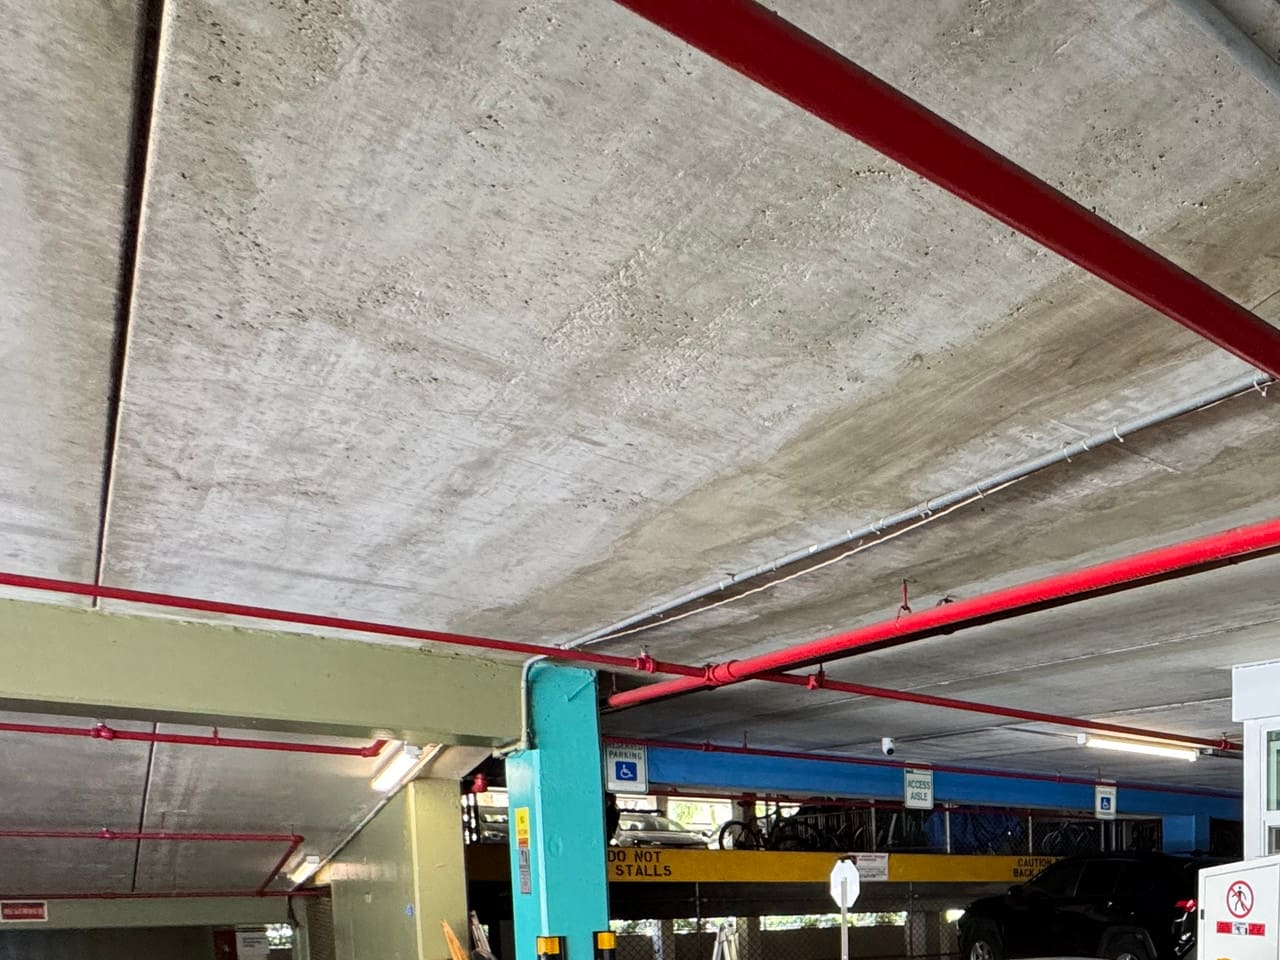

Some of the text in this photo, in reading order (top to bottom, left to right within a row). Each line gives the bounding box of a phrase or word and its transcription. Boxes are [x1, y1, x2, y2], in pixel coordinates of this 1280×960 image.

[608, 750, 643, 760] PARKING
[907, 780, 930, 790] ACCESS
[910, 791, 928, 801] AISLE
[607, 850, 662, 863] DO NOT
[615, 864, 672, 877] STALLS
